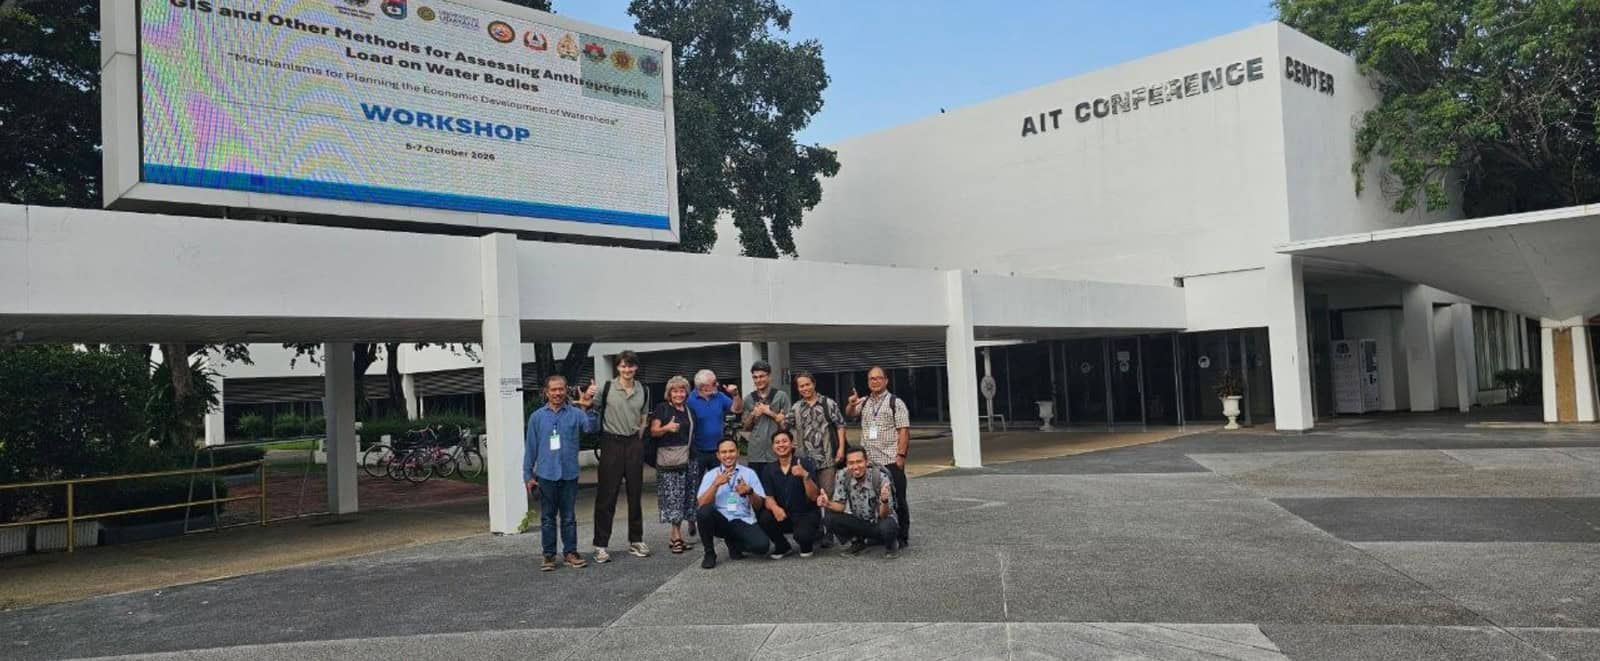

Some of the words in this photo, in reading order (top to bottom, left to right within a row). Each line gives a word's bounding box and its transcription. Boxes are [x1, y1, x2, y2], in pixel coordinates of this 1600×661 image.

[170, 0, 213, 13] GIS
[219, 7, 262, 22] and
[268, 15, 329, 36] Other
[334, 26, 420, 54] Methods
[425, 45, 451, 59] for
[455, 51, 541, 79] Assessing
[326, 69, 342, 79] for
[346, 71, 400, 90] Planning
[402, 81, 420, 93] the
[423, 86, 479, 102] Economic
[480, 96, 548, 114] Development
[550, 106, 563, 115] of
[345, 46, 393, 65] Load
[398, 59, 422, 71] on
[425, 61, 480, 80] Water
[484, 73, 539, 93] Bodies
[1021, 108, 1063, 137] AIT
[1074, 56, 1264, 123] CONFERENCE
[1284, 55, 1335, 96] CENTER
[360, 102, 530, 142] WORKSHOP
[425, 145, 468, 157] October
